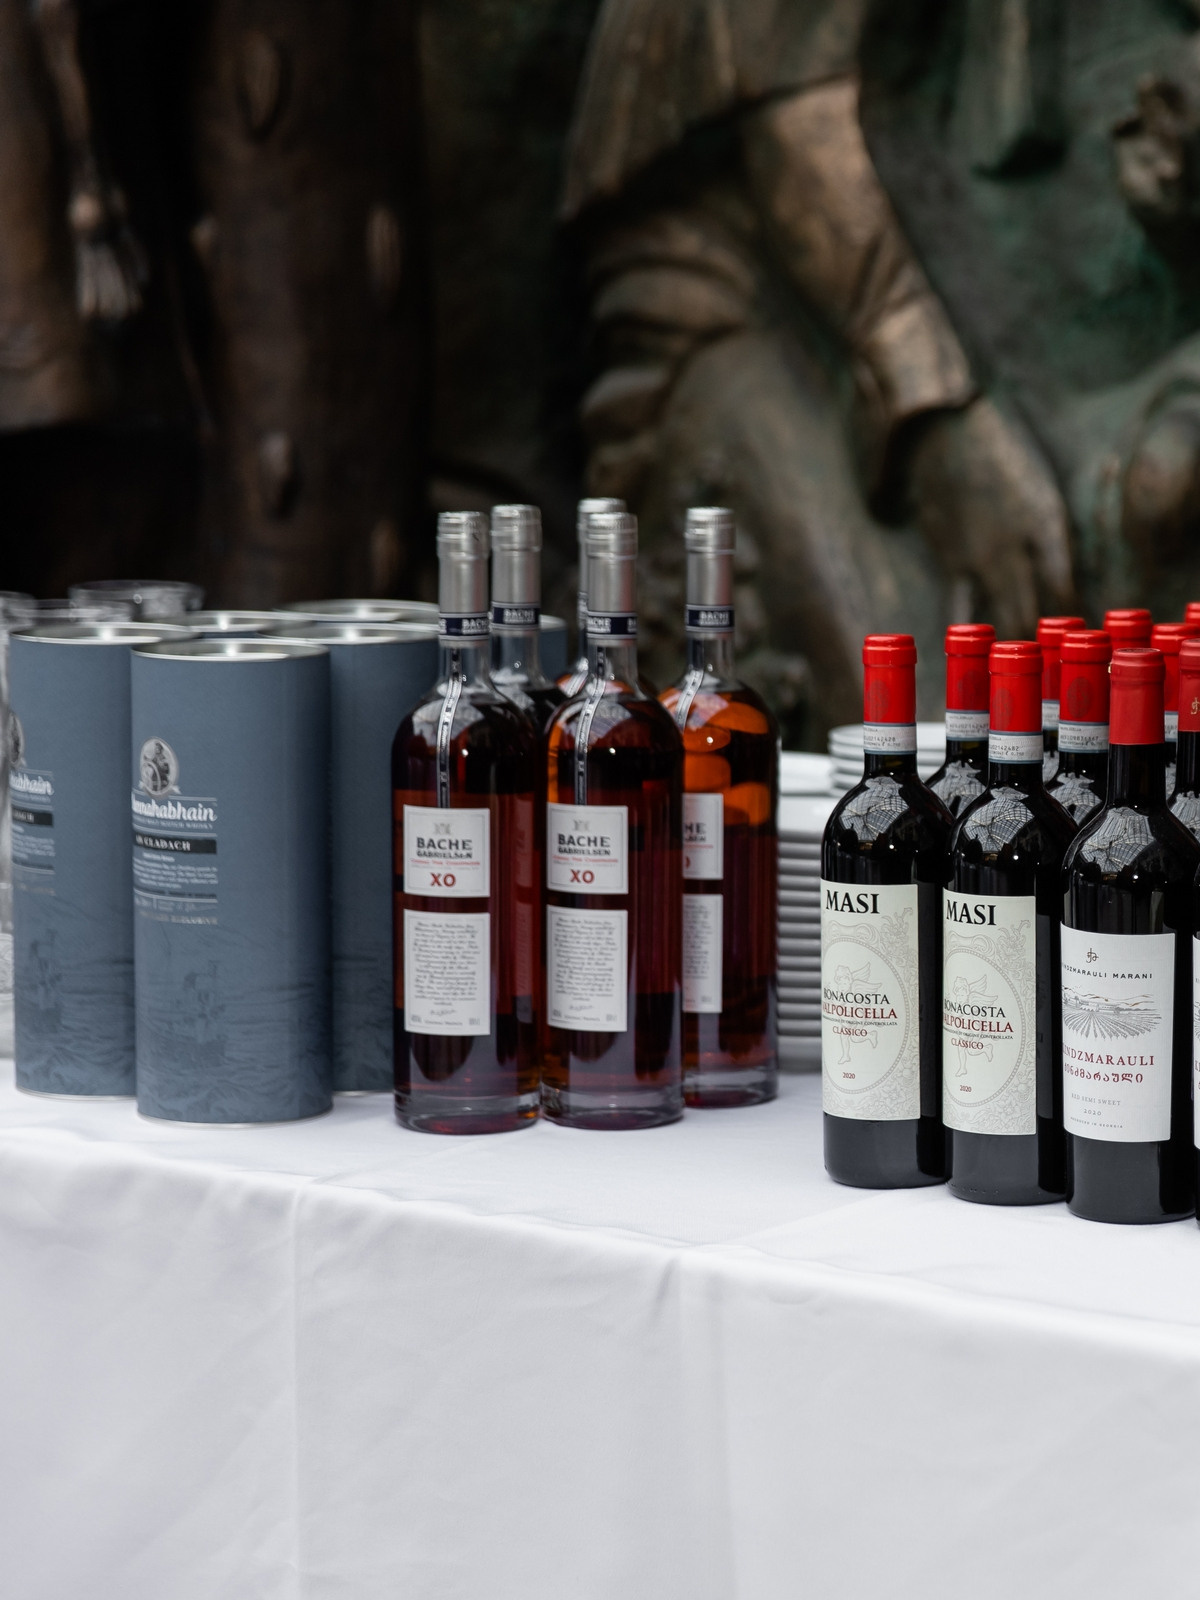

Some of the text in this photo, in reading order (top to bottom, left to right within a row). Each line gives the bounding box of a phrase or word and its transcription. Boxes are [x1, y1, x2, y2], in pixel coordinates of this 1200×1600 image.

[416, 836, 473, 851] BACHE
[557, 833, 611, 848] BACHE
[430, 871, 456, 888] XO
[569, 868, 595, 884] XO
[825, 889, 880, 914] MASI
[946, 899, 997, 926] MASI
[1062, 963, 1107, 978] NDZMARAULI
[823, 987, 891, 1005] BONACOSTA
[832, 1025, 868, 1037] CLASSICO
[950, 1037, 984, 1050] CLASSICO
[1063, 1044, 1155, 1066] INDZMARAULI
[842, 1071, 856, 1080] 2020
[959, 1084, 972, 1093] 2020
[1098, 1098, 1121, 1106] SWEET
[1083, 1108, 1102, 1116] 2020
